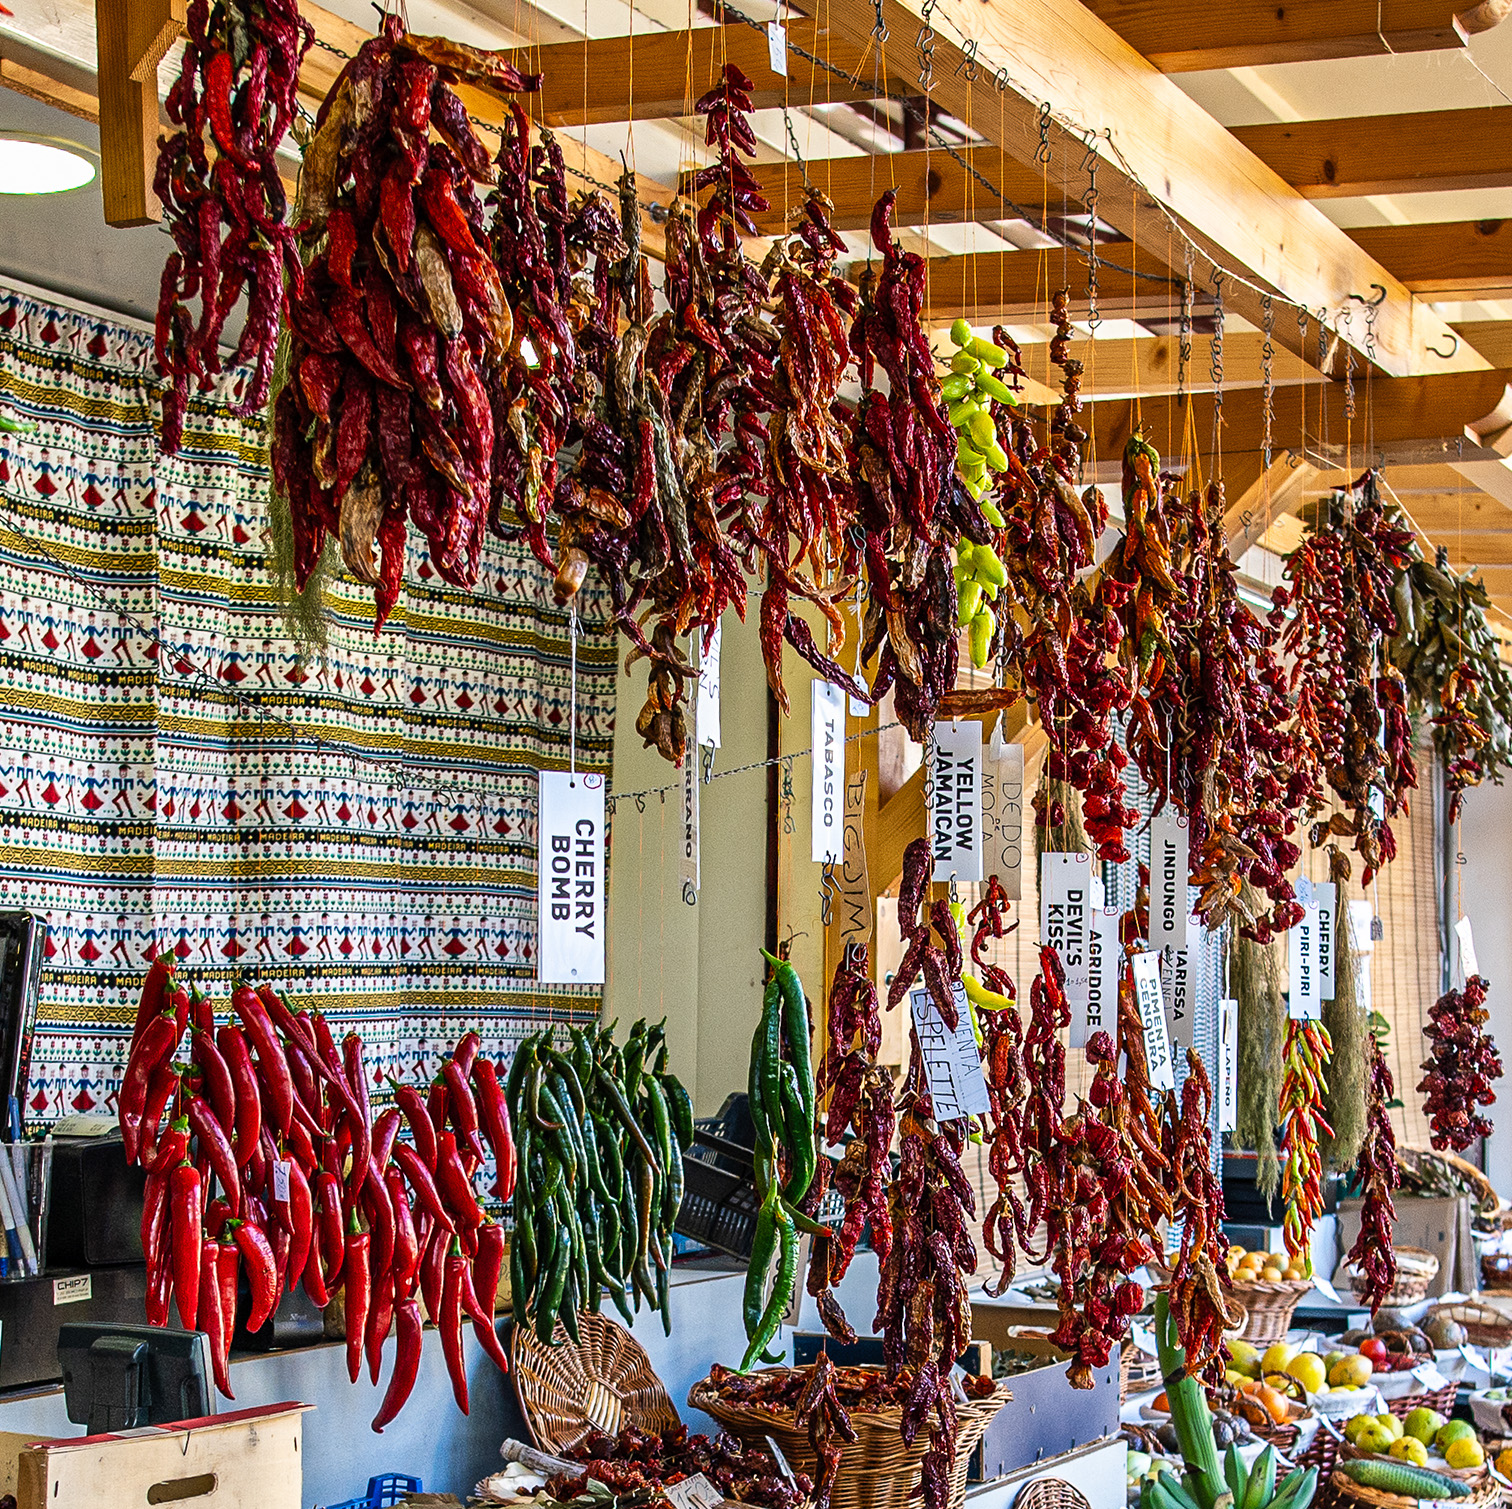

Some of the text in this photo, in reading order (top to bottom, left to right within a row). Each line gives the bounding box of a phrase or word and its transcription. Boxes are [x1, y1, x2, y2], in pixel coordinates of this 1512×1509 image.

[18, 350, 54, 368] MADEIRA
[17, 504, 54, 520] MADEIRA
[161, 539, 201, 554] MADEIRA
[684, 737, 694, 858] SERRANO
[822, 718, 836, 828] TABASCO
[934, 745, 954, 862] JAMAICAN
[955, 757, 975, 851] YELLOW
[19, 816, 59, 829] MADEIRA
[551, 835, 571, 921] BOMB
[575, 818, 596, 940] CHERRY
[840, 862, 867, 938] JIM
[1163, 839, 1176, 932] JINDUNGO
[1048, 904, 1064, 951] KISS
[1066, 889, 1084, 967] DEVIL'S
[1299, 925, 1311, 997] PIRI-PIRI
[1086, 929, 1103, 1027] AGRIDOCE
[953, 992, 981, 1077] PIMENTA
[1139, 979, 1159, 1072] CENOURA
[1148, 978, 1168, 1066] PIMENTA
[57, 1278, 89, 1291] CHIP7
